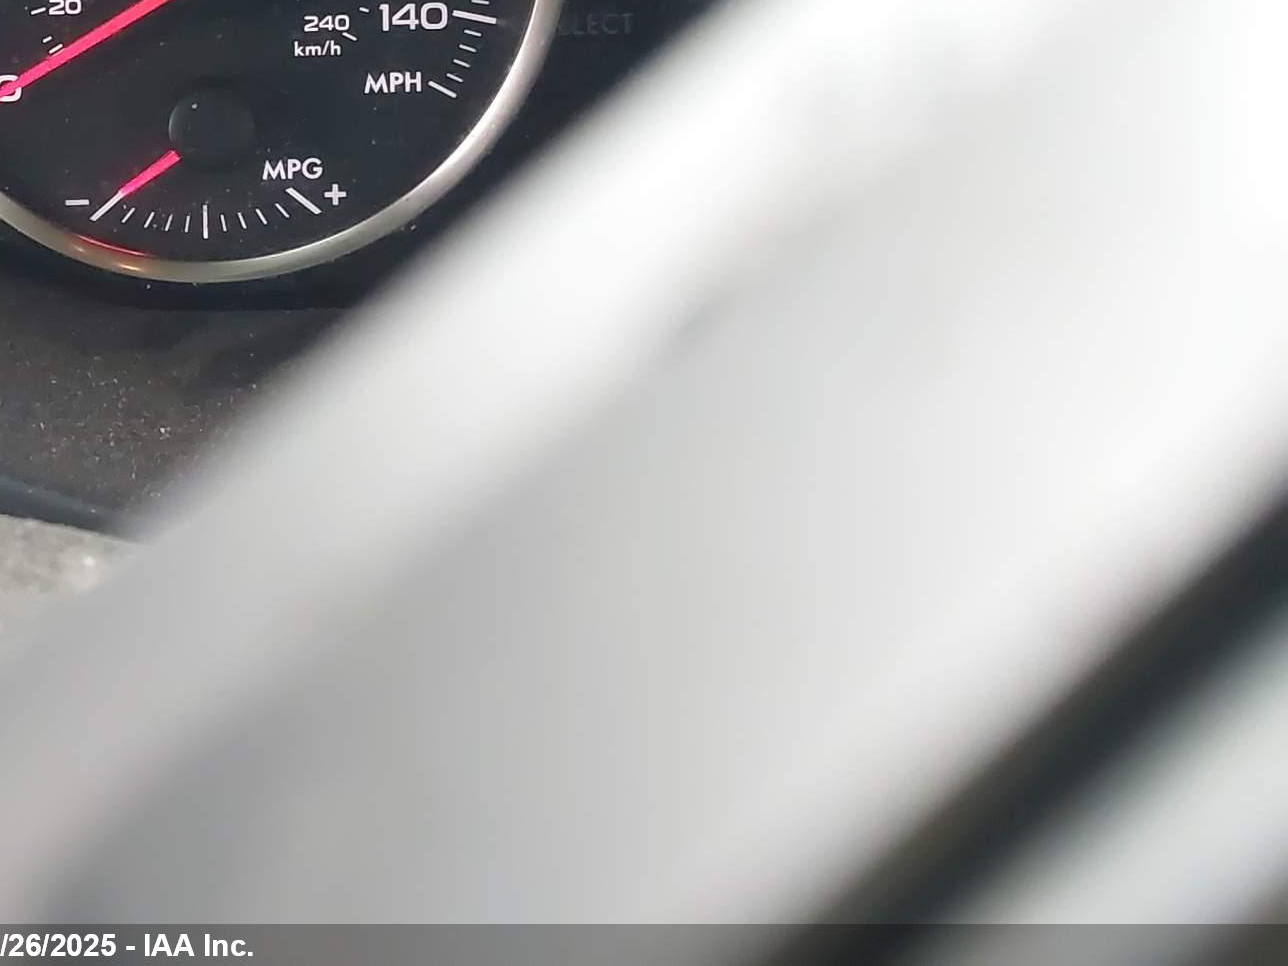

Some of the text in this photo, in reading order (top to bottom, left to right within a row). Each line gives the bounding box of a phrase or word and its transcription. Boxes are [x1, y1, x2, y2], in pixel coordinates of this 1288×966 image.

[303, 14, 349, 32] 240
[378, 2, 448, 32] 140
[294, 39, 341, 57] km/h
[364, 71, 422, 94] MPH
[262, 158, 323, 181] MPG
